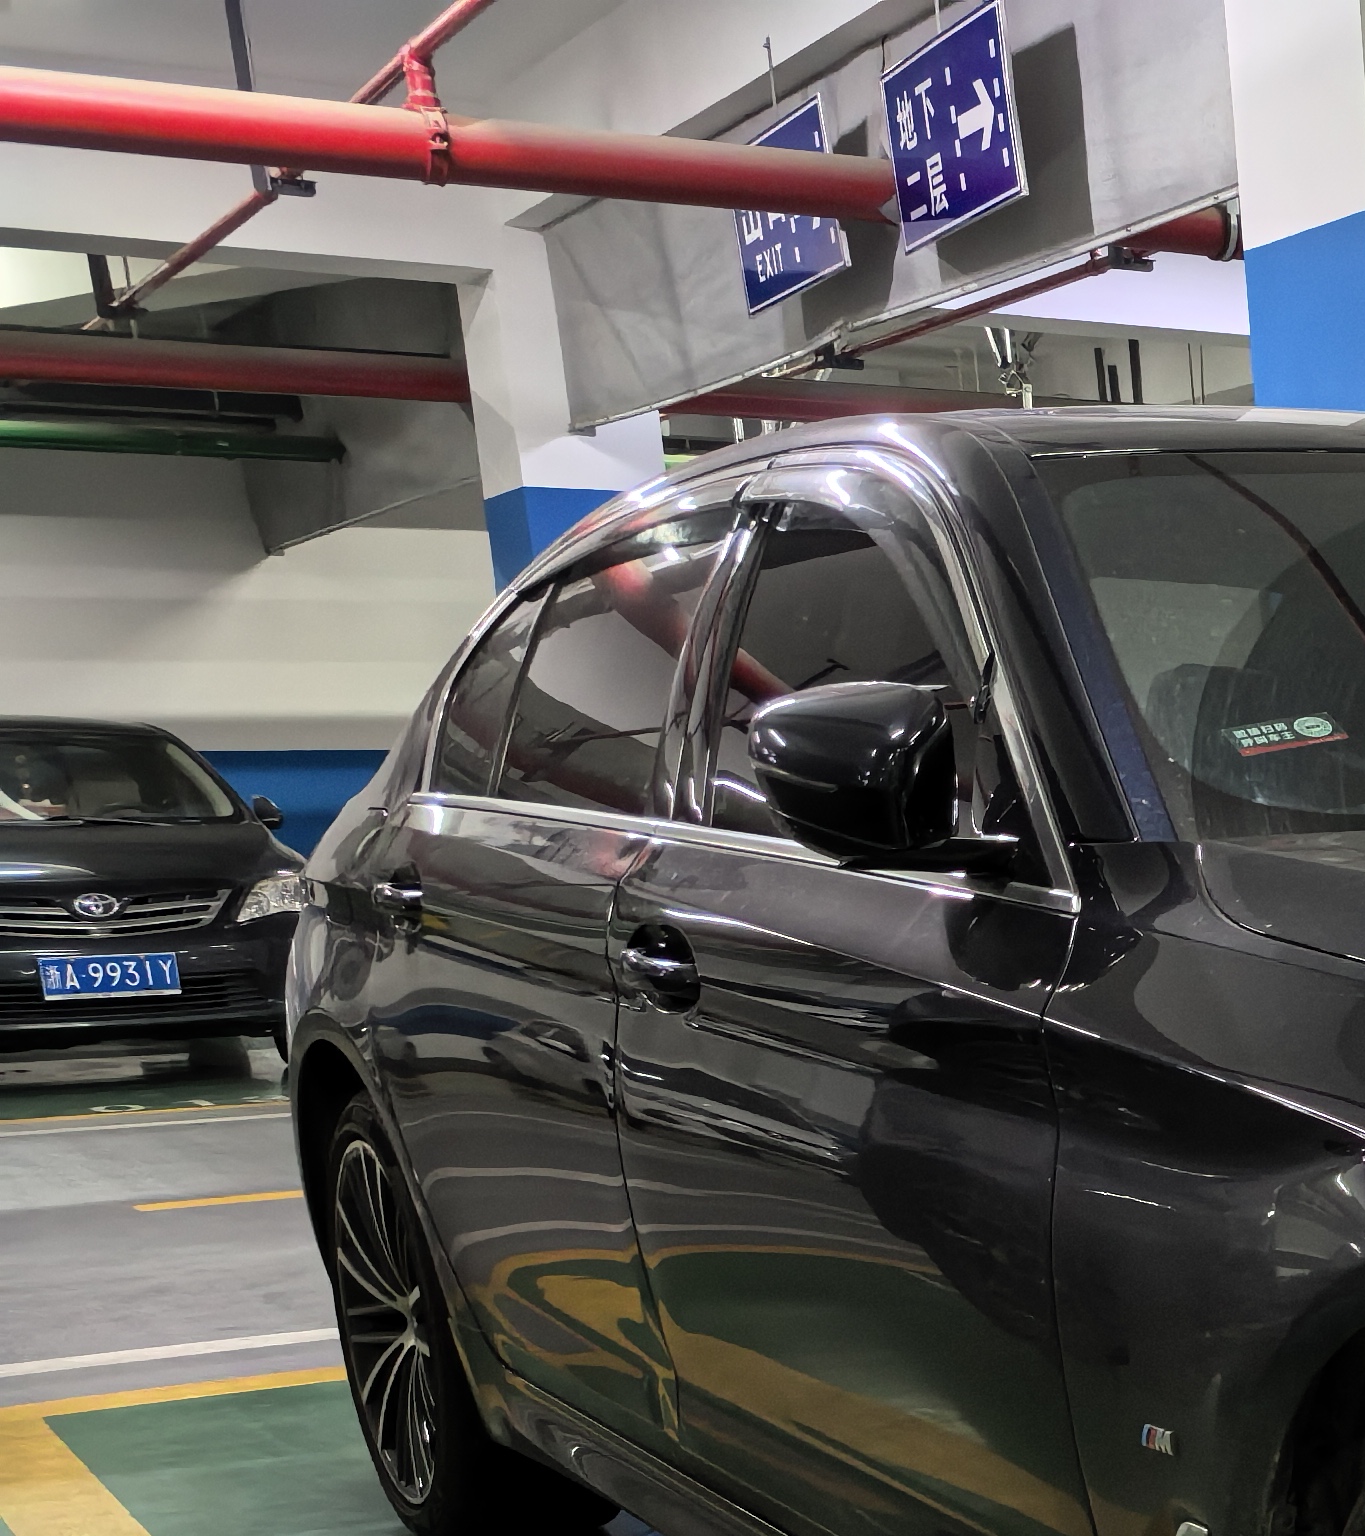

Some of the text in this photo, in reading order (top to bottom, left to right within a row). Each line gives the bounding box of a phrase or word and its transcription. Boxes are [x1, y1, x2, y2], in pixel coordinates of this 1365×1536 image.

[896, 78, 935, 151] 地下
[906, 152, 949, 220] 二层
[755, 242, 784, 283] EXIT
